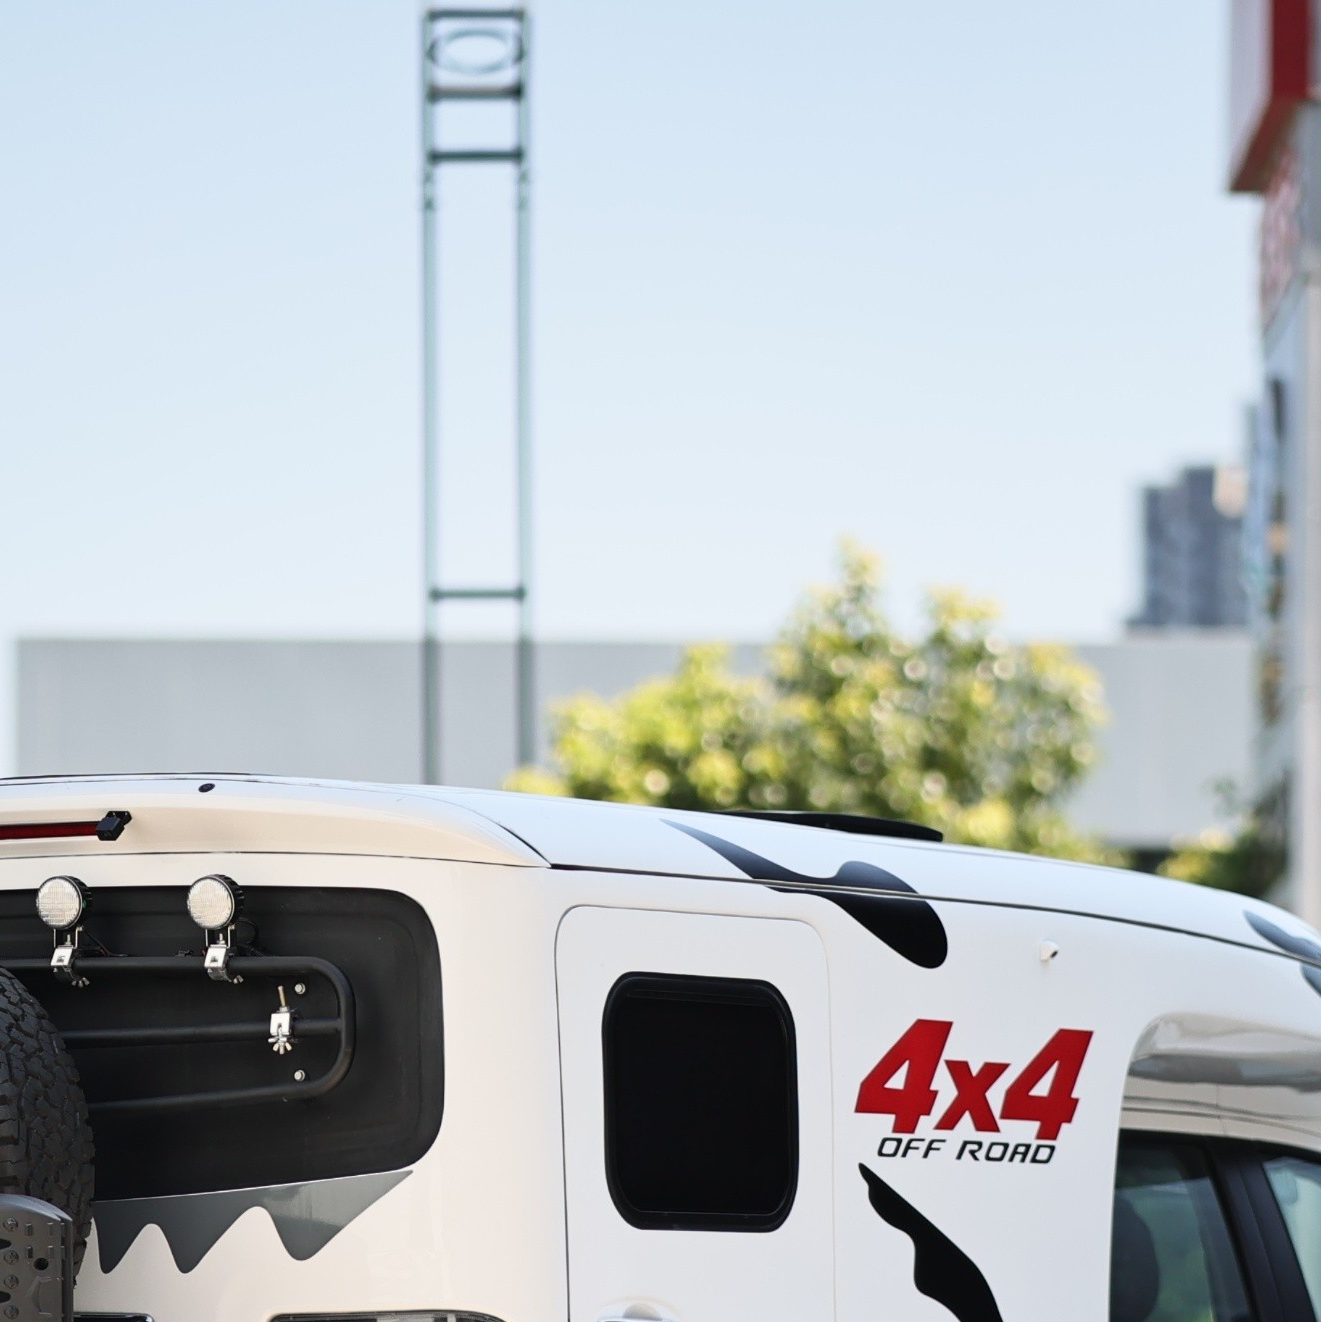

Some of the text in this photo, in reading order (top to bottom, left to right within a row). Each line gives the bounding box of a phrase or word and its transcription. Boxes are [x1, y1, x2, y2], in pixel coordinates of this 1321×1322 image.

[854, 1018, 1094, 1141] 4x4
[877, 1137, 1056, 1164] OFF ROAD
